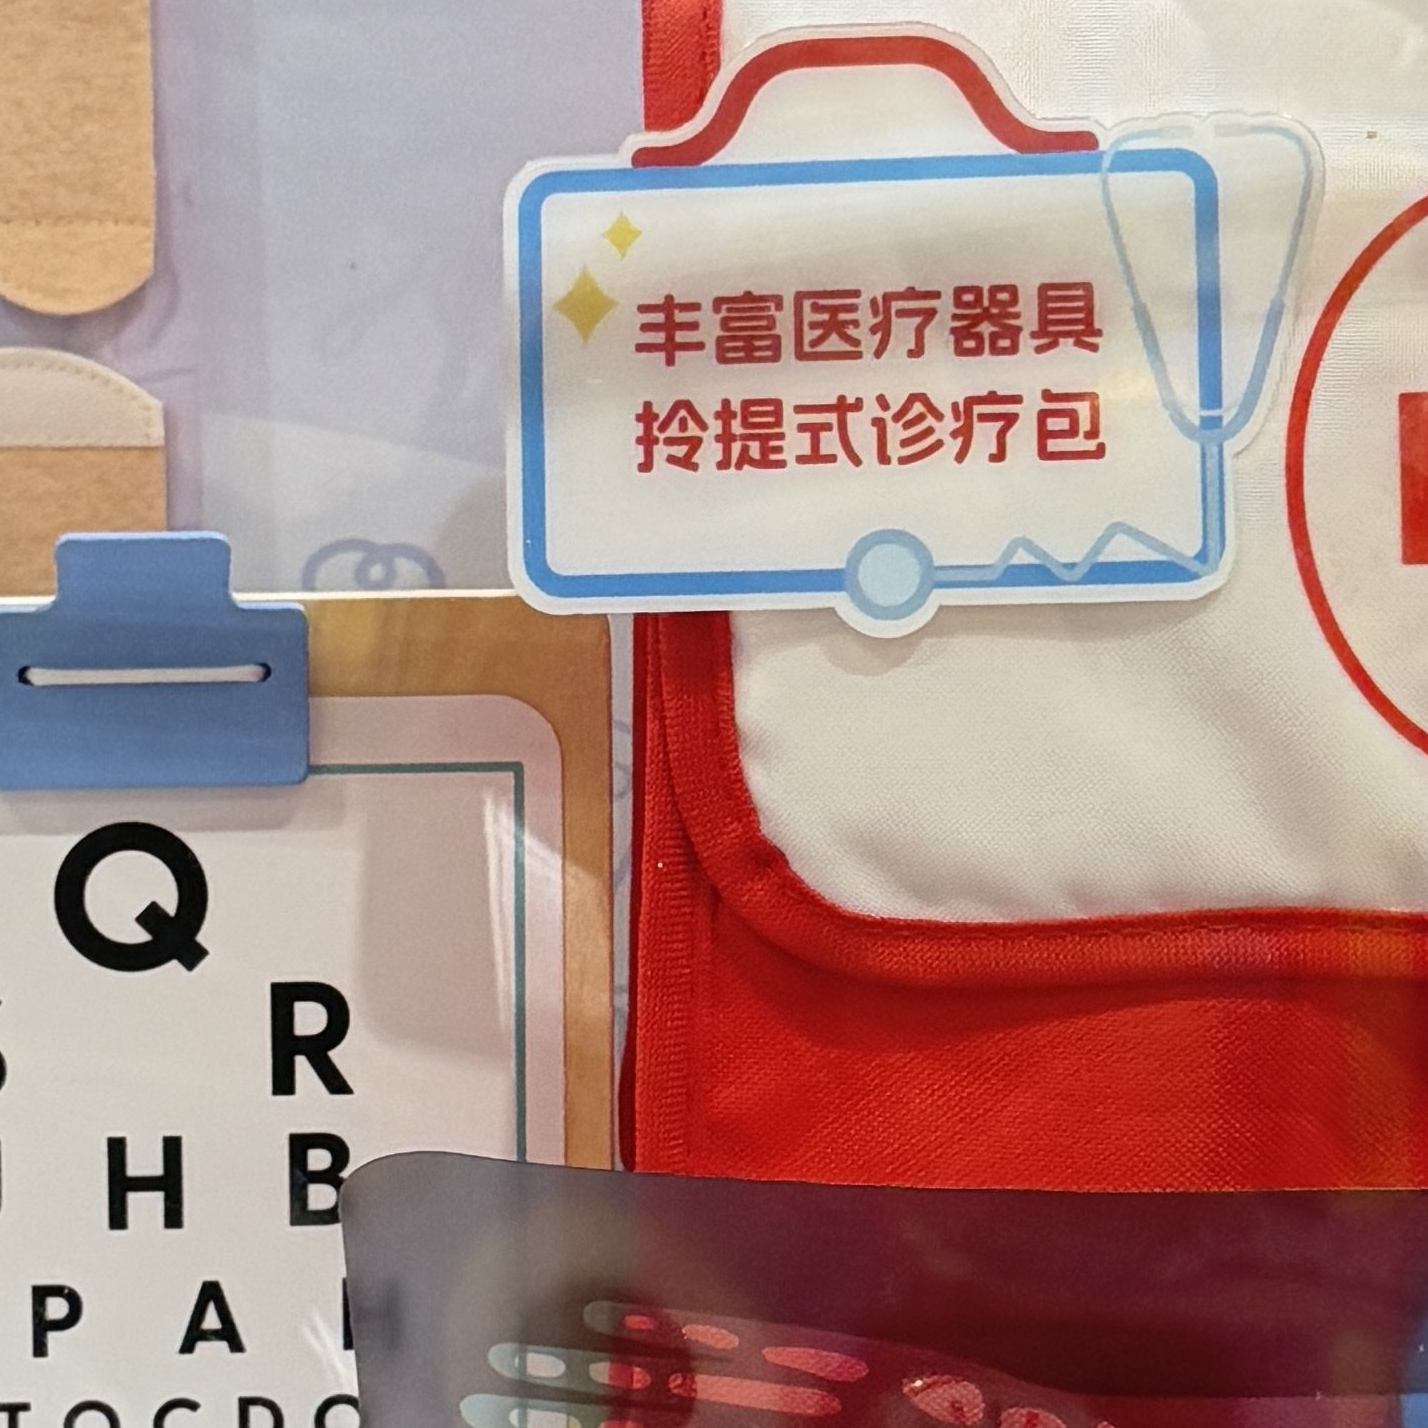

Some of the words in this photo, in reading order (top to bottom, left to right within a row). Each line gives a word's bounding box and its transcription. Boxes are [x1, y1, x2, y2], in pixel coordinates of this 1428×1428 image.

[634, 282, 1103, 368] 丰富医疗器具
[634, 389, 1106, 473] 拎提式诊疗包
[54, 821, 209, 972] Q
[270, 981, 354, 1096] R
[107, 1135, 184, 1230] H
[288, 1132, 351, 1227] B
[31, 1284, 84, 1358] P
[178, 1280, 246, 1355] A
